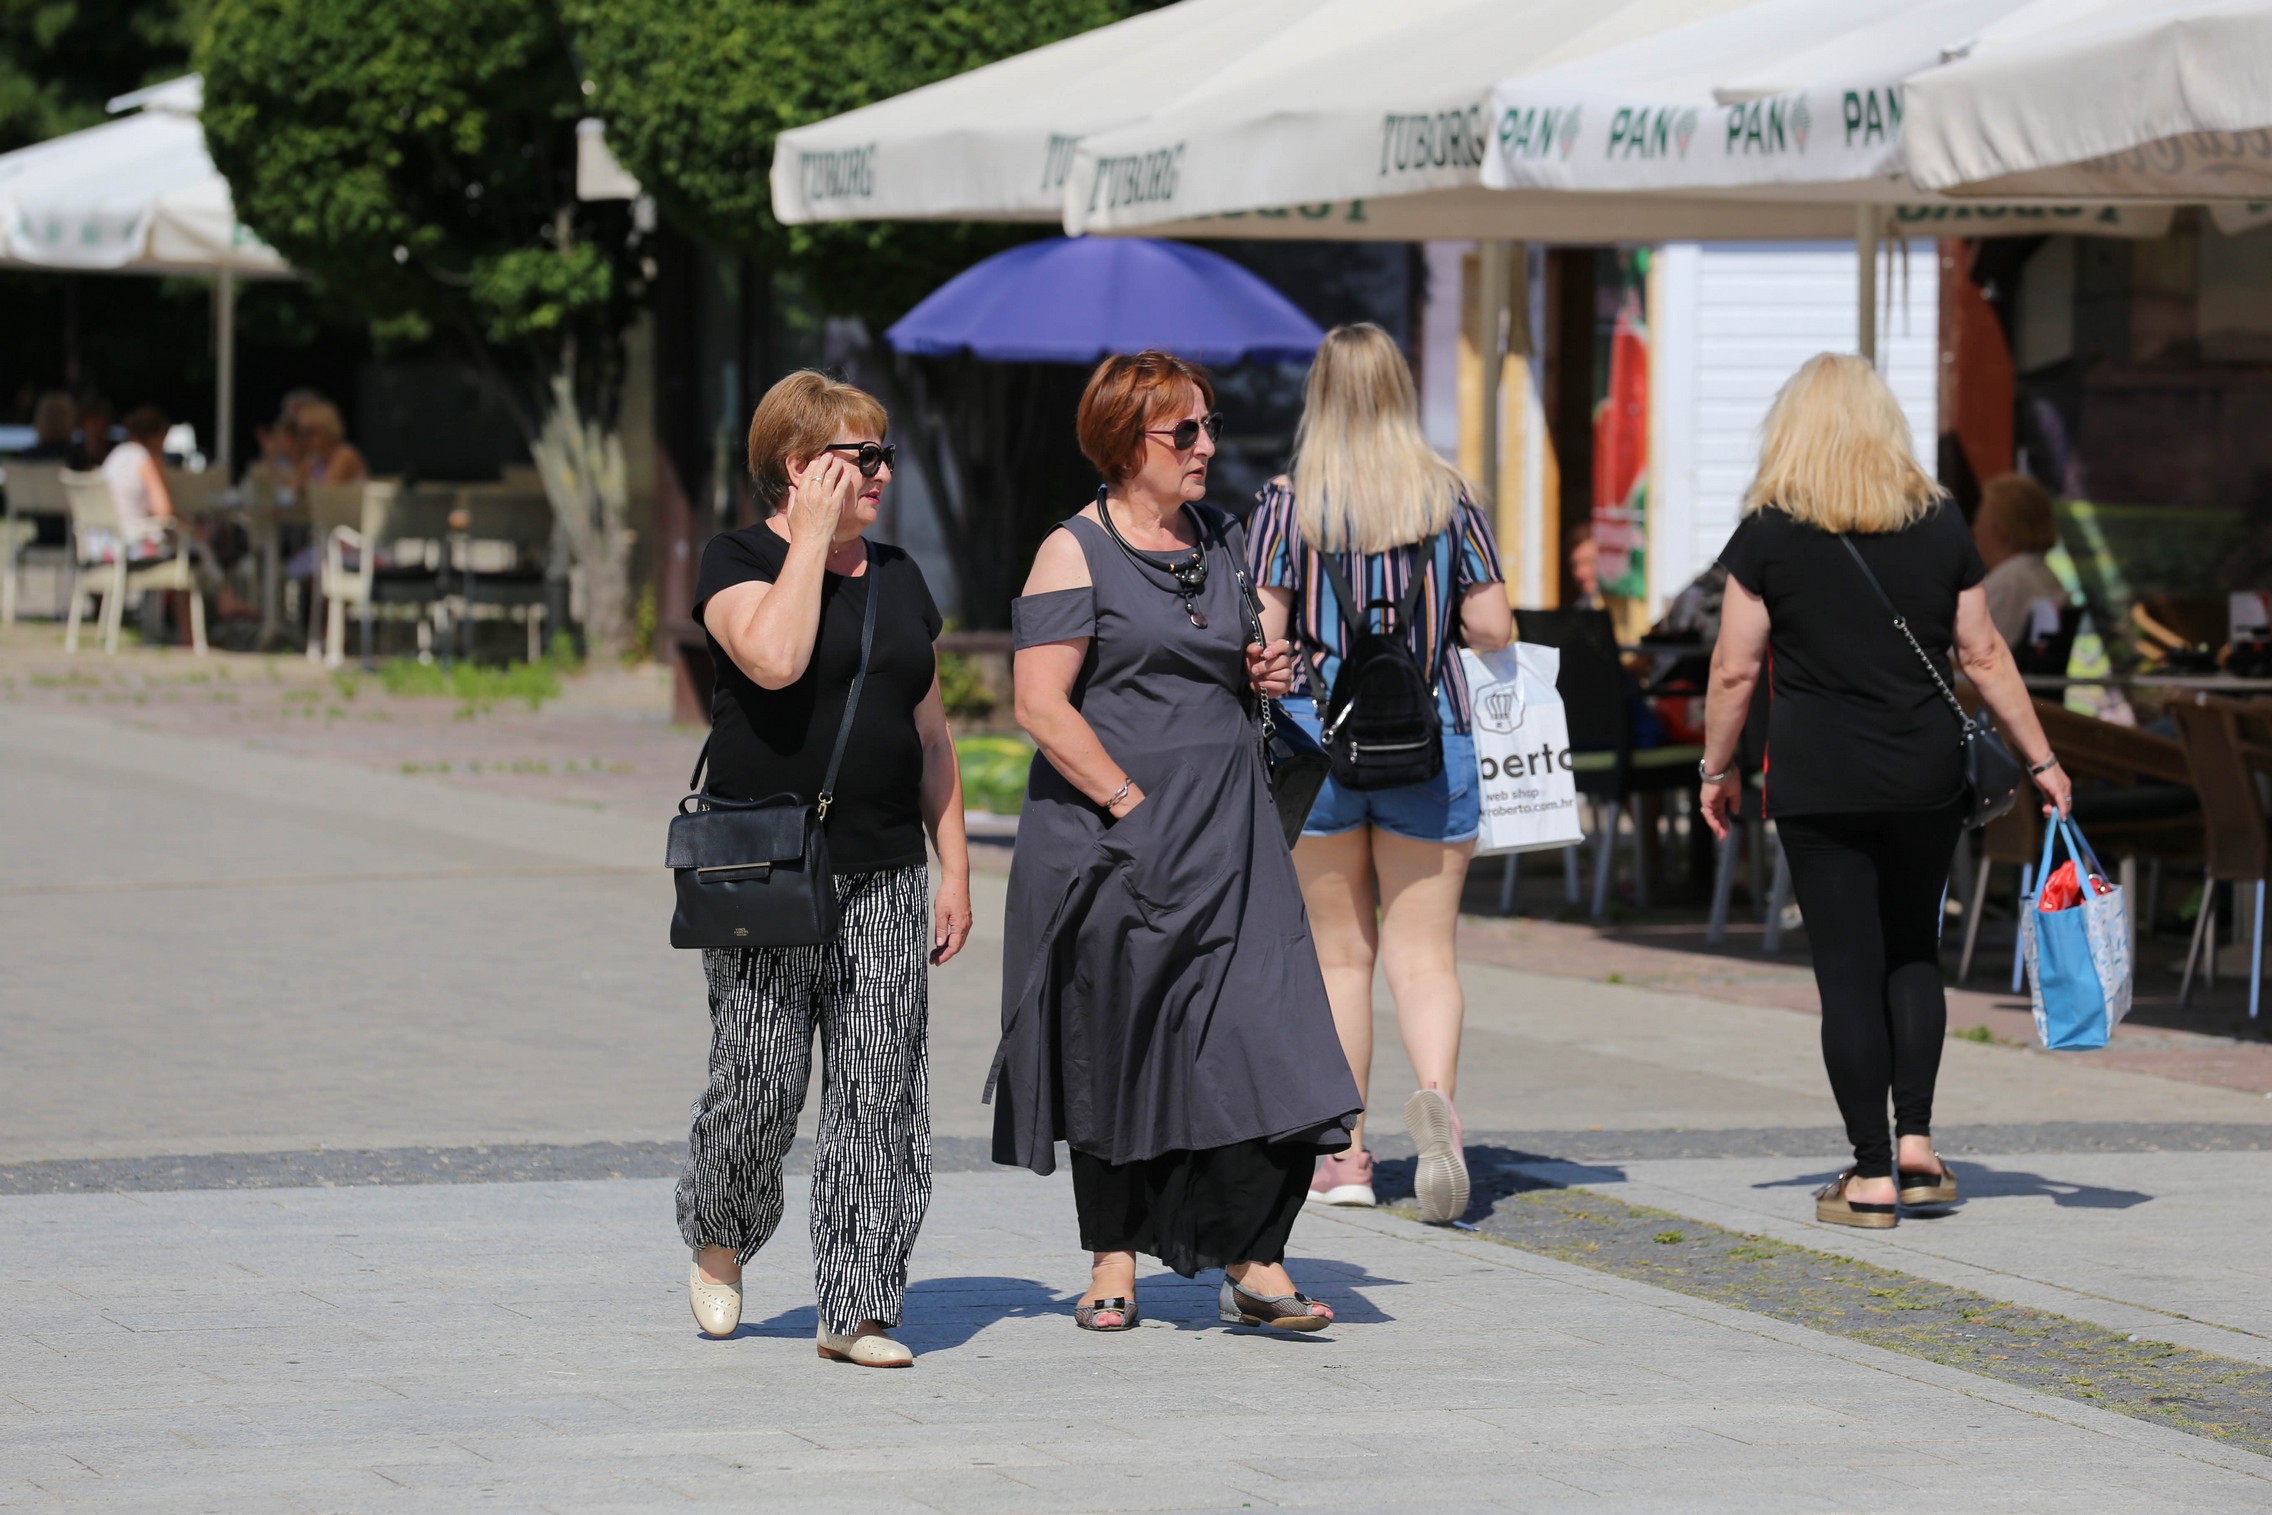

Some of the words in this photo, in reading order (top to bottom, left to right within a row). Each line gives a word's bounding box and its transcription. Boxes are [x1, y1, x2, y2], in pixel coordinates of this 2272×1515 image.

[1380, 105, 1486, 176] TUBORG
[1606, 107, 1677, 159] PAN
[1726, 96, 1787, 155] PAN
[1486, 790, 1508, 801] web
[1512, 788, 1539, 799] shop
